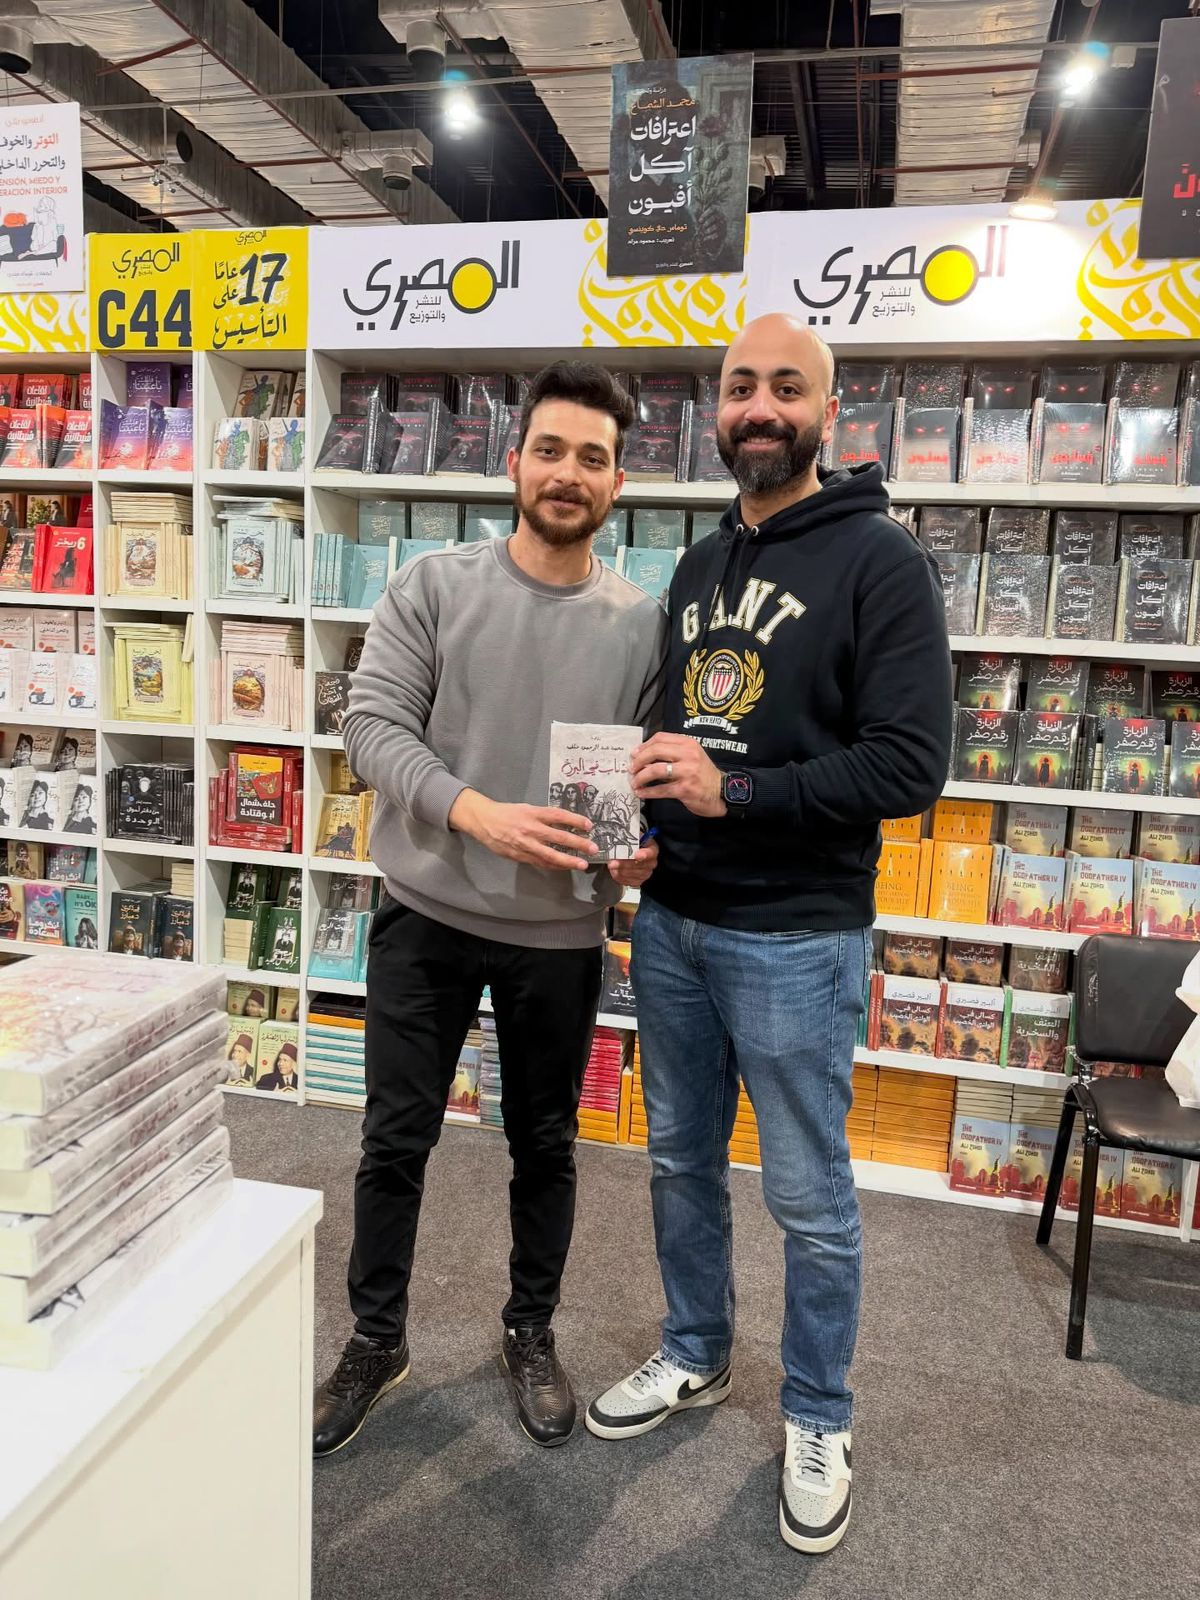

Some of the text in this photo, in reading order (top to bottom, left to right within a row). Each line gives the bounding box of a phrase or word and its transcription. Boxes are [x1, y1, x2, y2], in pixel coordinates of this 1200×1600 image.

[630, 115, 697, 146] اعترافات
[34, 132, 59, 150] التوتر
[32, 155, 66, 172] والتحرر
[629, 145, 695, 183] آكل
[33, 185, 68, 195] INTERIOR
[628, 179, 693, 216] أفيون
[240, 252, 288, 306] 17
[342, 239, 521, 331] المصري
[212, 284, 239, 309] على
[414, 294, 442, 309] للنشر
[880, 285, 912, 301] للنشر
[409, 309, 446, 323] والتوزيع
[872, 301, 916, 317] والتوزيع
[98, 289, 192, 348] C44
[1137, 581, 1168, 593] اعترافات
[1136, 593, 1166, 606] آكل
[976, 719, 1002, 731] الزيارة
[1122, 726, 1149, 738] الزيارة
[702, 737, 748, 754] SPORTSWEAR
